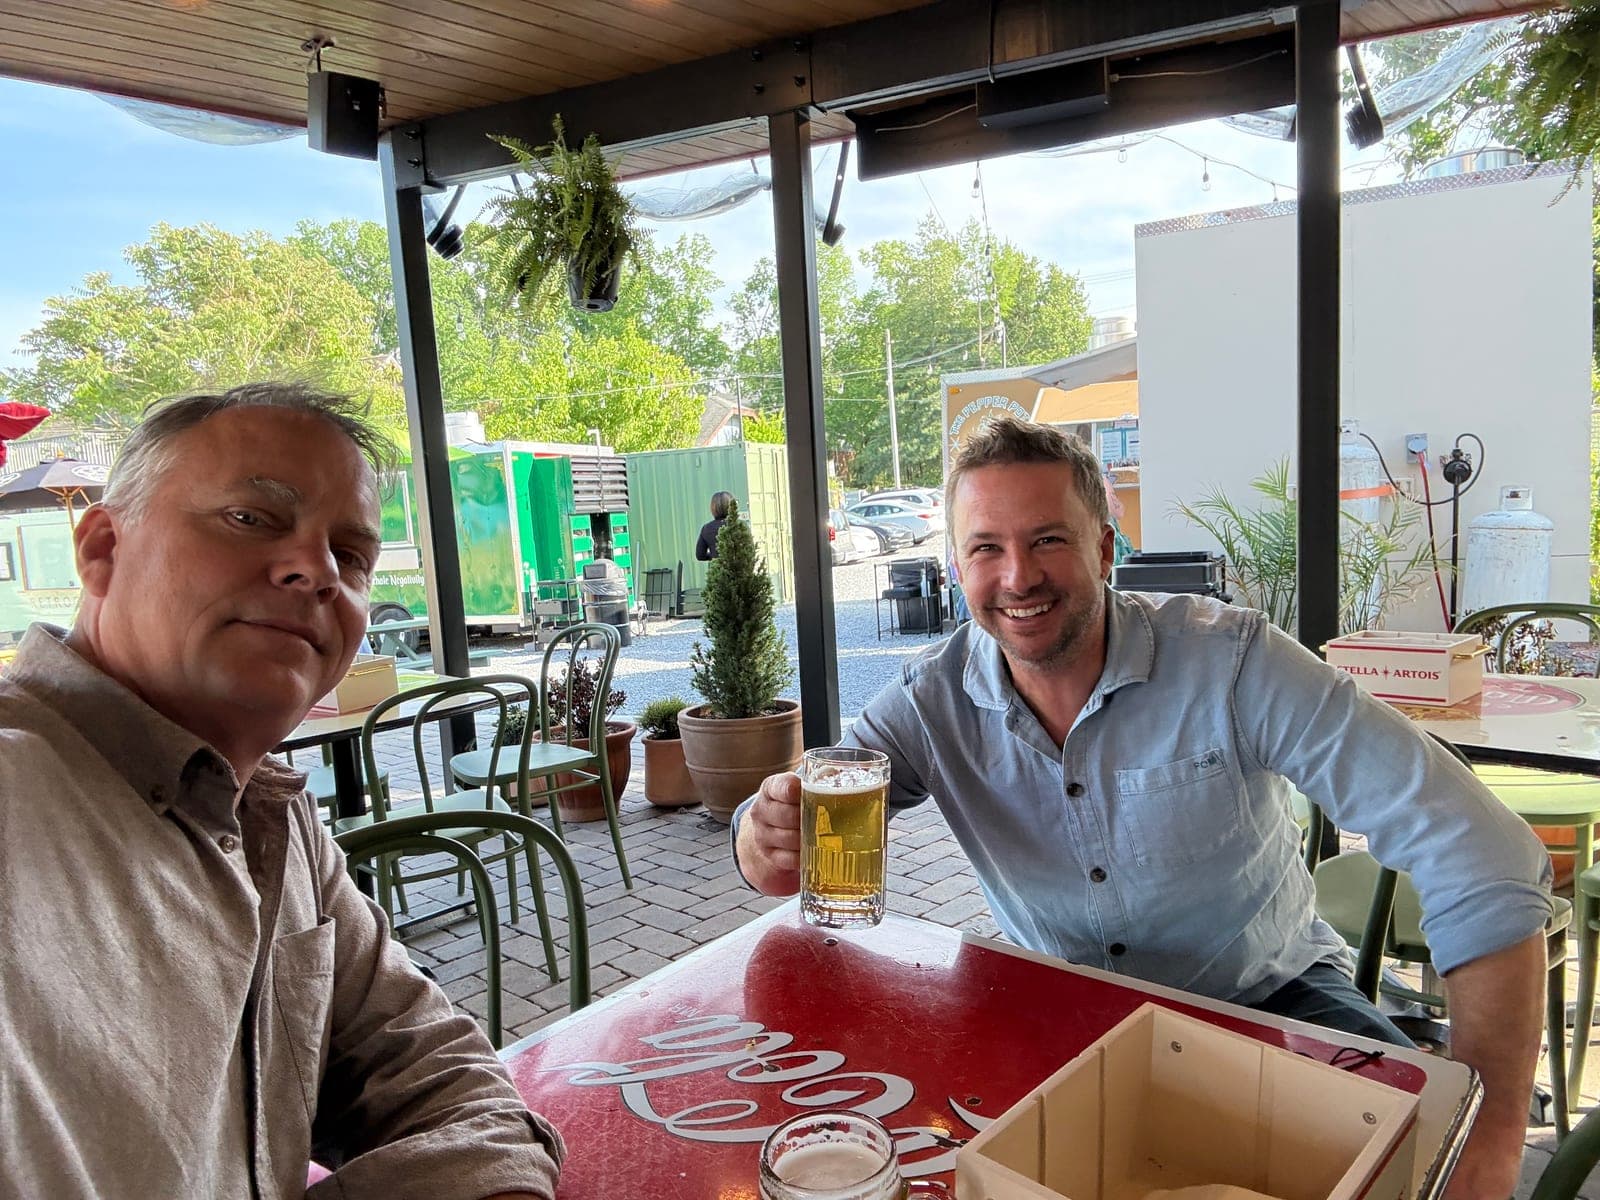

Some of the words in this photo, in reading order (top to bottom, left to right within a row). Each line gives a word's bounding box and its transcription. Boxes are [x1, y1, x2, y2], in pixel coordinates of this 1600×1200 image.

[949, 414, 966, 435] THE
[961, 395, 1009, 418] PEPPER
[1393, 669, 1440, 680] ARTOIS
